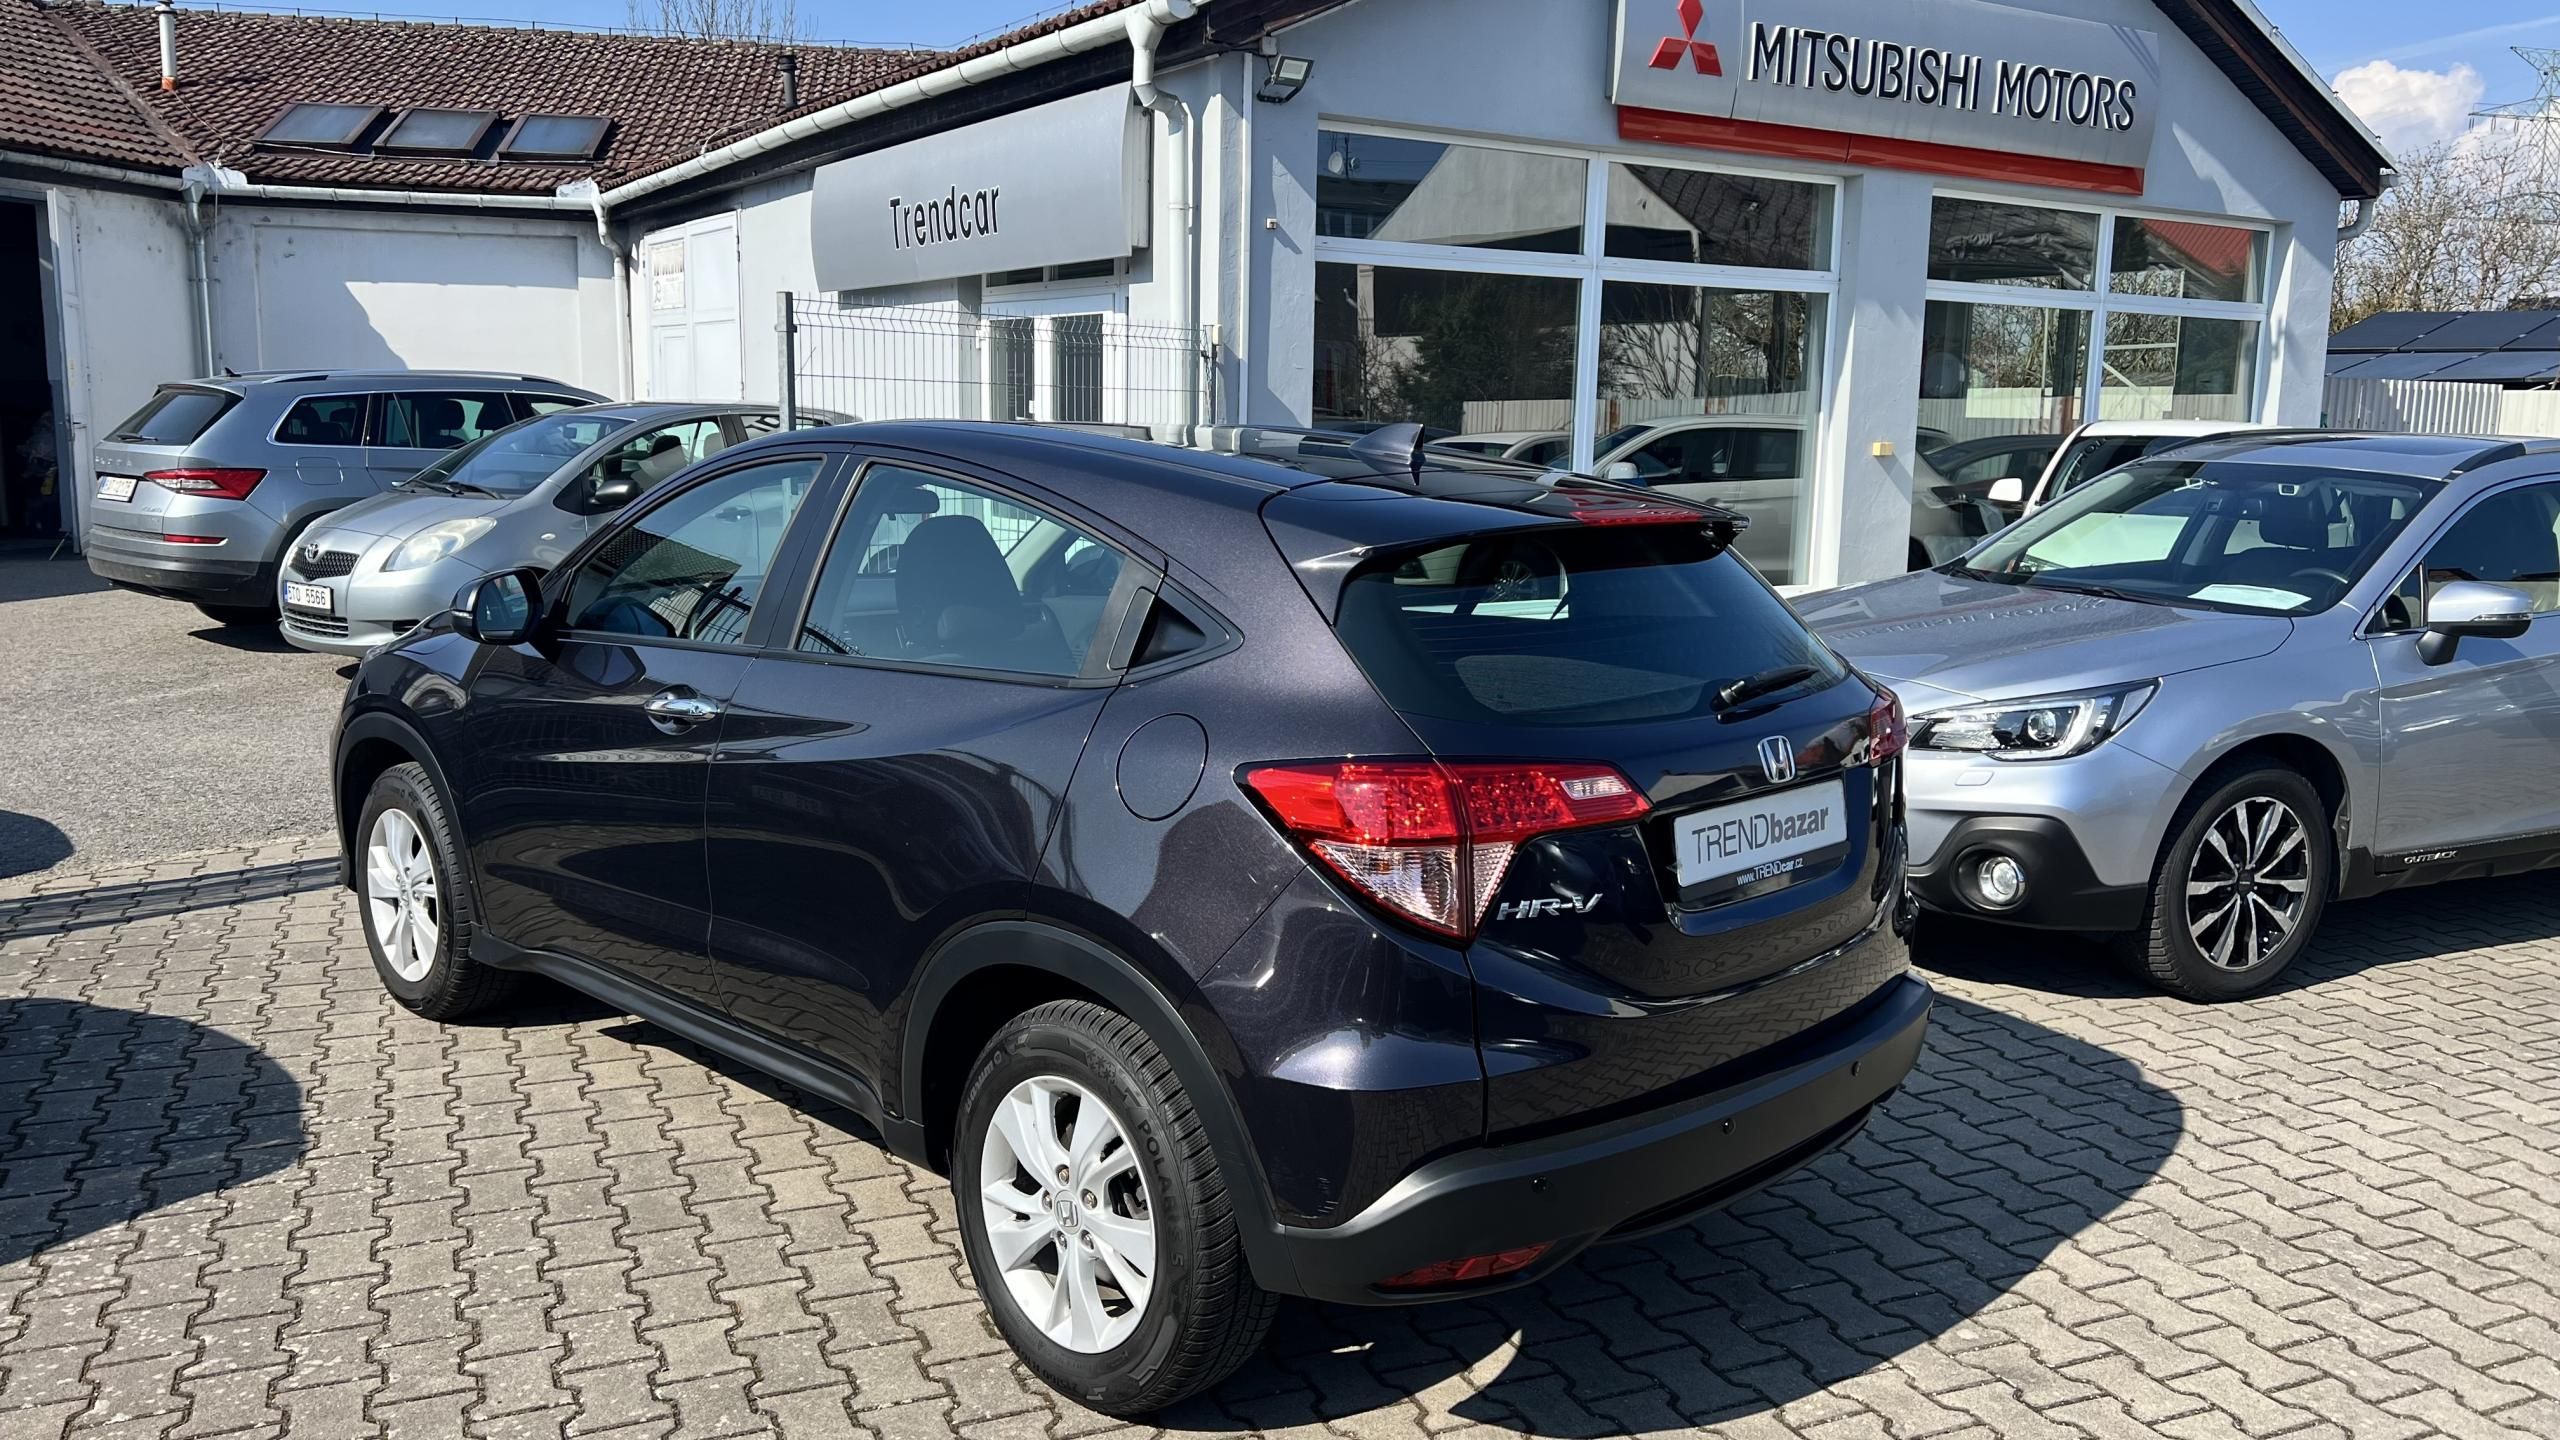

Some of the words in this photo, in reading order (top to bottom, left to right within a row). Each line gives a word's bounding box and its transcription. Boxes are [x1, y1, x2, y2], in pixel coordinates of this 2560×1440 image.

[1747, 22, 1983, 111] MITSUBISHI
[1992, 59, 2137, 131] MOTORS
[889, 185, 1000, 249] Trendcar
[305, 588, 326, 606] 5566
[1691, 806, 1829, 864] TRENDbazar
[1736, 857, 1804, 886] www.TRENDcar.cz
[1497, 893, 1603, 920] HR-V
